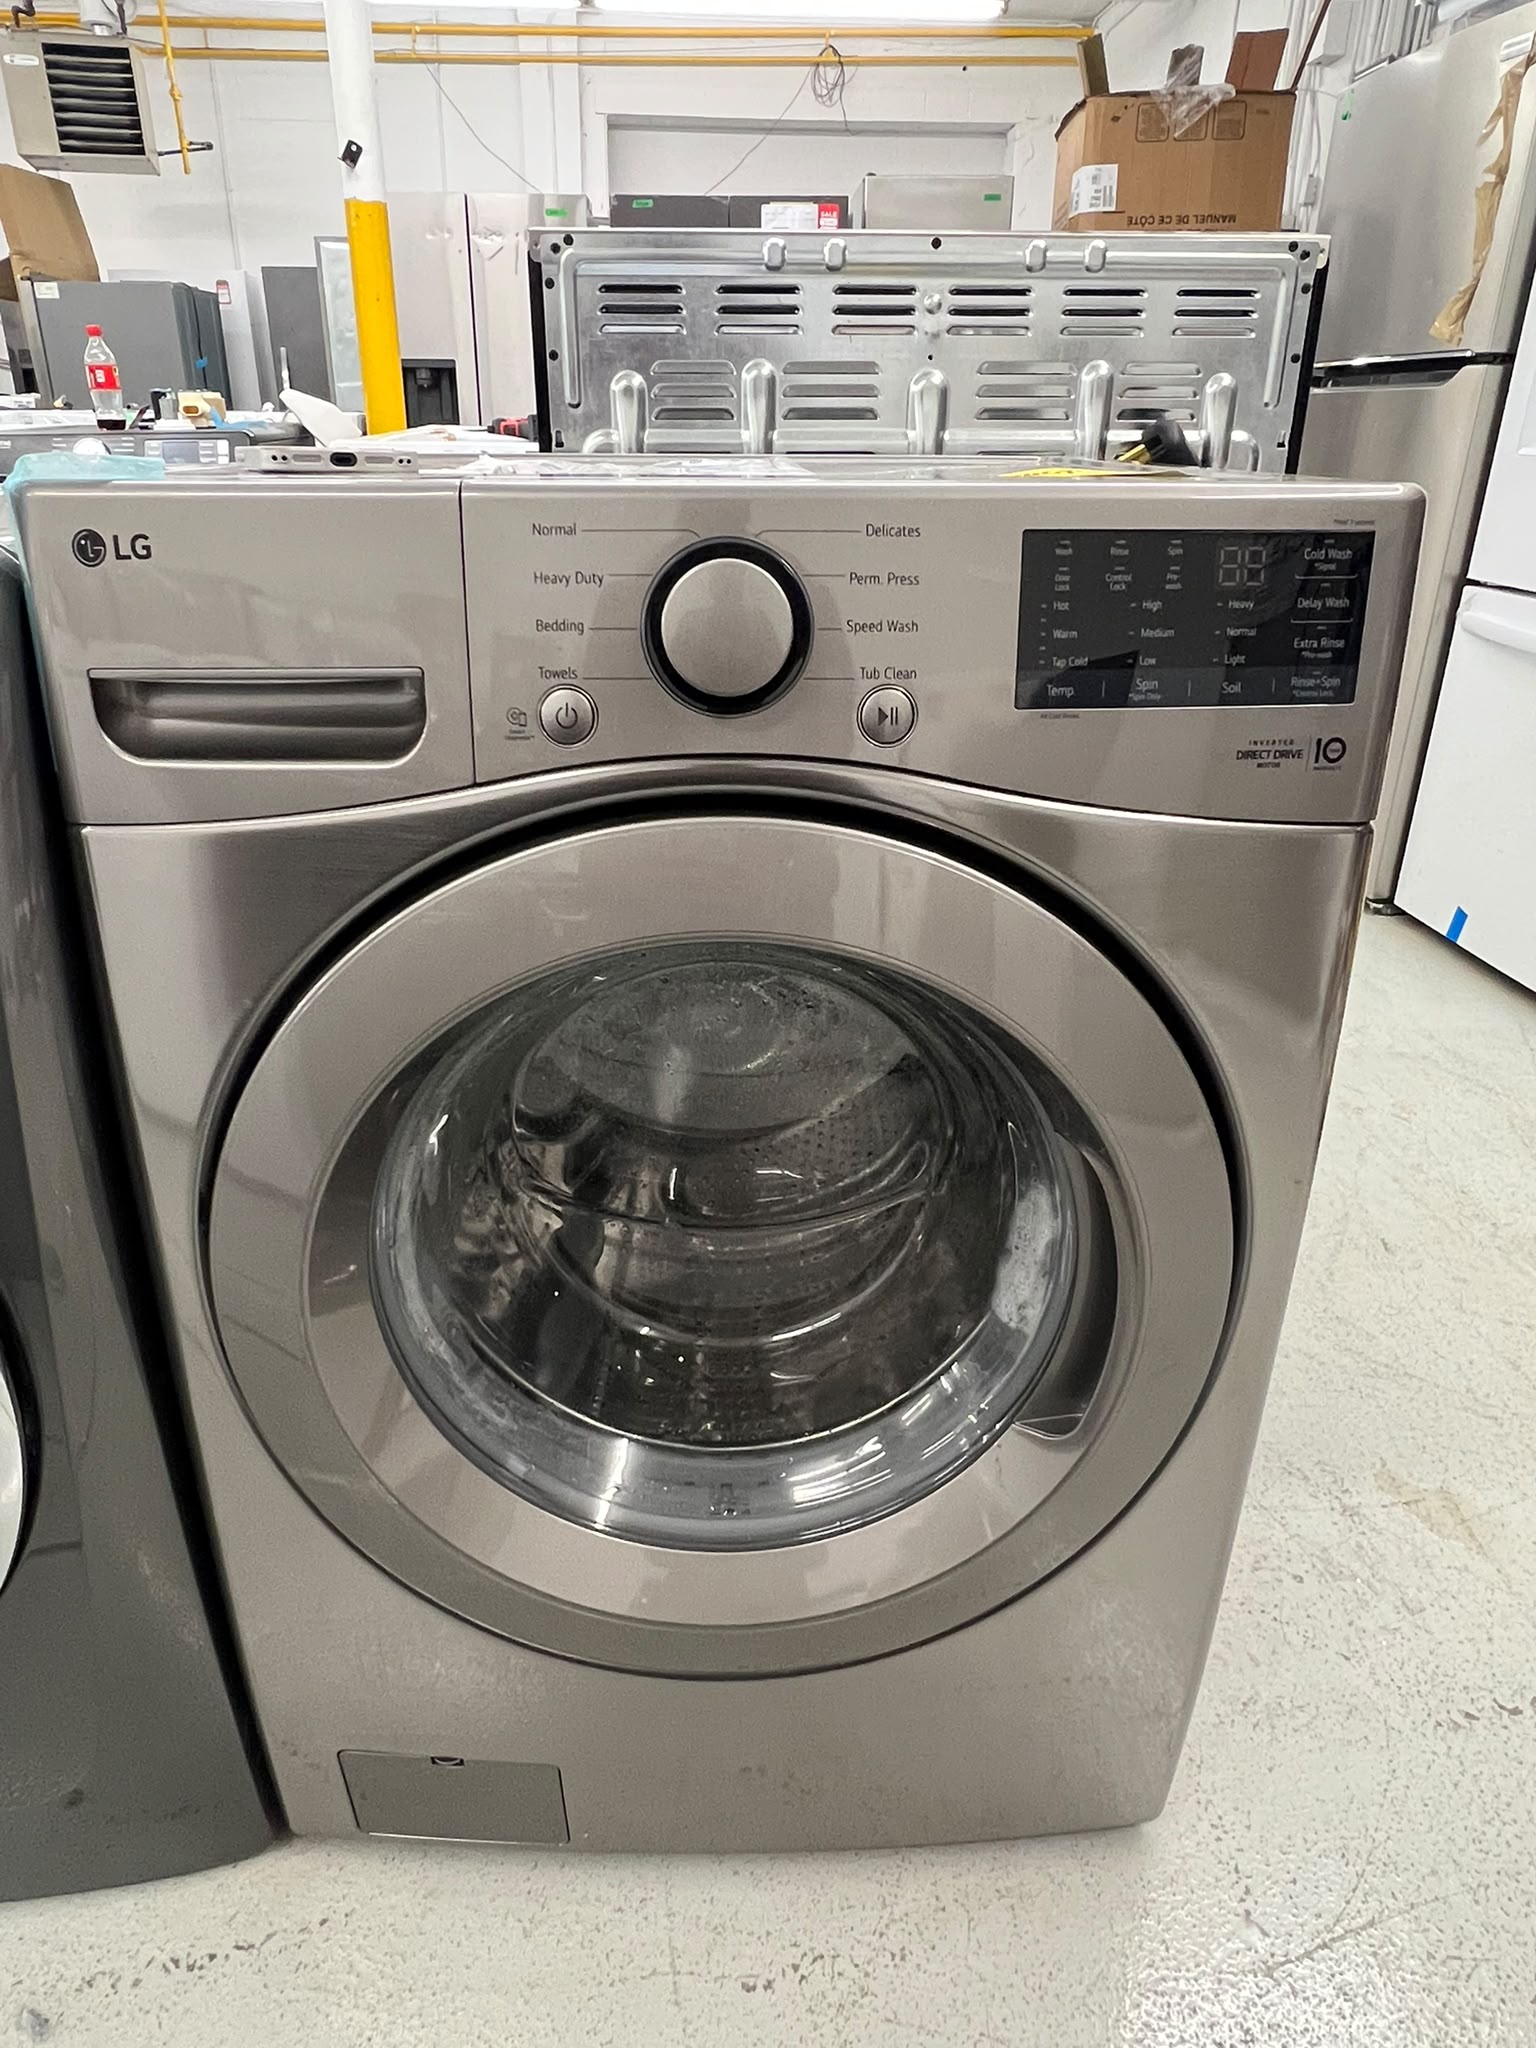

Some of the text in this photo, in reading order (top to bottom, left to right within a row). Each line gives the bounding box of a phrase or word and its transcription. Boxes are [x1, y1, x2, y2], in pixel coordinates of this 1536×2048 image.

[1158, 215, 1173, 225] CE
[1174, 214, 1190, 224] DE
[1192, 214, 1237, 225] MANUEL
[532, 523, 577, 536] Normal
[865, 523, 921, 537] Delicates
[112, 533, 152, 561] LG
[1168, 546, 1184, 556] Spin
[1304, 548, 1353, 560] Cold Wash
[533, 571, 604, 588] Heavy Duty
[849, 572, 920, 586] Perm. Press
[1105, 573, 1133, 582] Control
[1110, 583, 1126, 591] Lock
[1053, 601, 1070, 611] Hot
[1142, 601, 1163, 613] High
[1228, 599, 1255, 612] Heavy
[1297, 597, 1351, 611] Delay Wash
[535, 618, 585, 636] Bedding
[846, 619, 919, 636] Speed Wash
[1140, 628, 1175, 638] Medium
[1227, 626, 1257, 637] Normal
[1053, 629, 1078, 639] Warm
[1294, 636, 1345, 649] Extra Rinse
[1052, 656, 1089, 669] Tap Cold
[1139, 656, 1157, 666] Low
[1224, 653, 1246, 667] Light
[538, 666, 578, 680] Towels
[860, 666, 917, 680] Tub Clean
[1135, 677, 1159, 692] Spin
[1221, 681, 1242, 695] Soil
[1046, 684, 1075, 699] Temp
[1236, 748, 1304, 761] DIRECT DRIVE
[1314, 736, 1347, 764] 10
